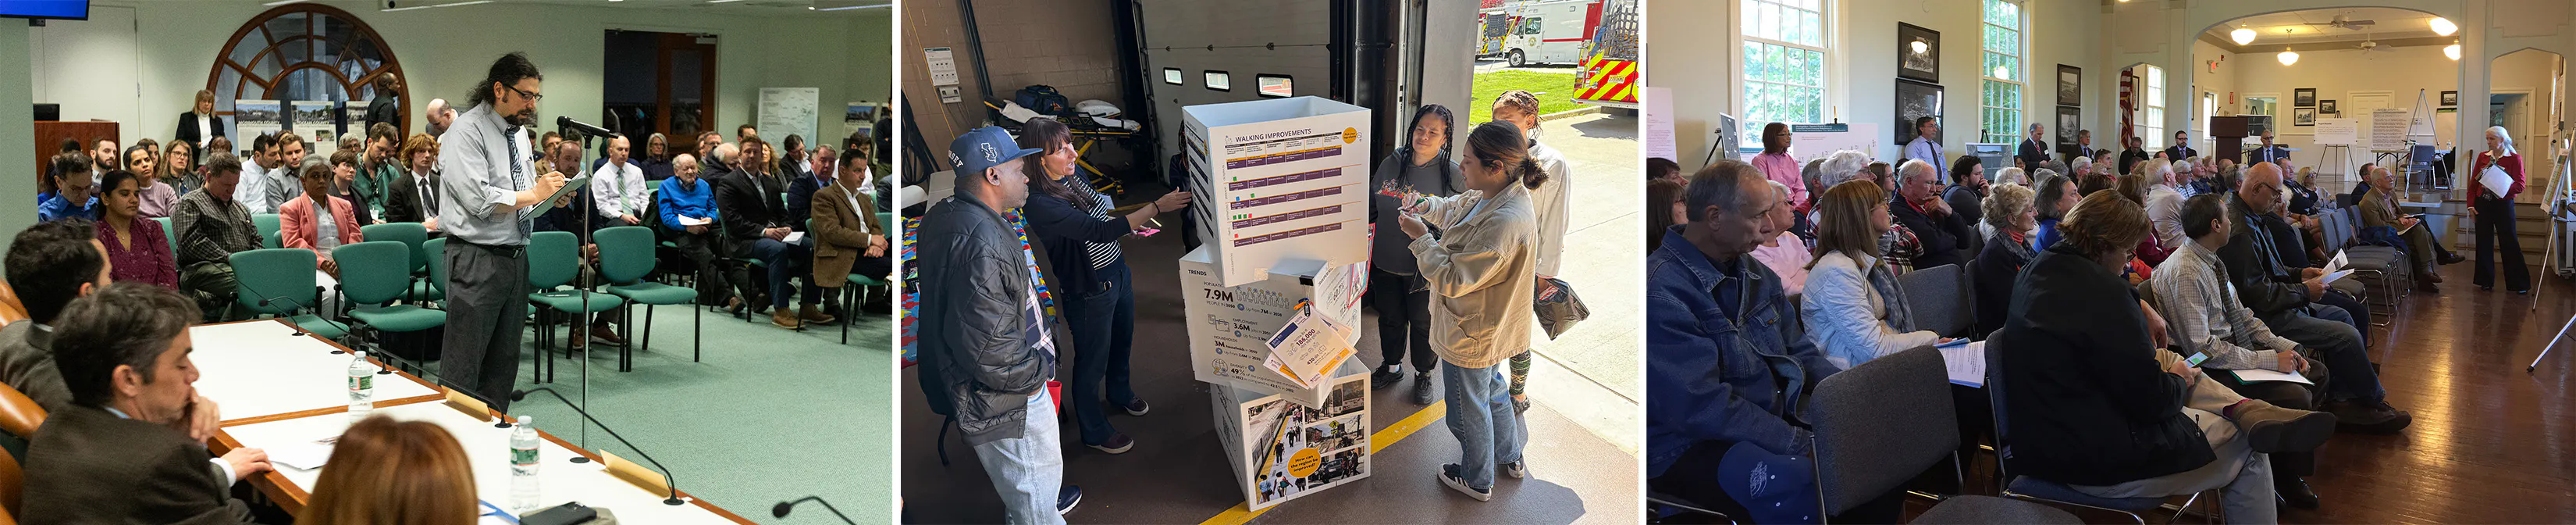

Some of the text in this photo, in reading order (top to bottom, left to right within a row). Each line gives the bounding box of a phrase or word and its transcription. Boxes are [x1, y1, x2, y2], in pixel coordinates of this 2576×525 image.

[1265, 128, 1311, 139] IMPROVEMENTS
[1204, 288, 1233, 302] 7.9M
[1233, 323, 1250, 331] 3.6M
[1296, 329, 1315, 346] 186,000
[1294, 463, 1315, 472] improved?
